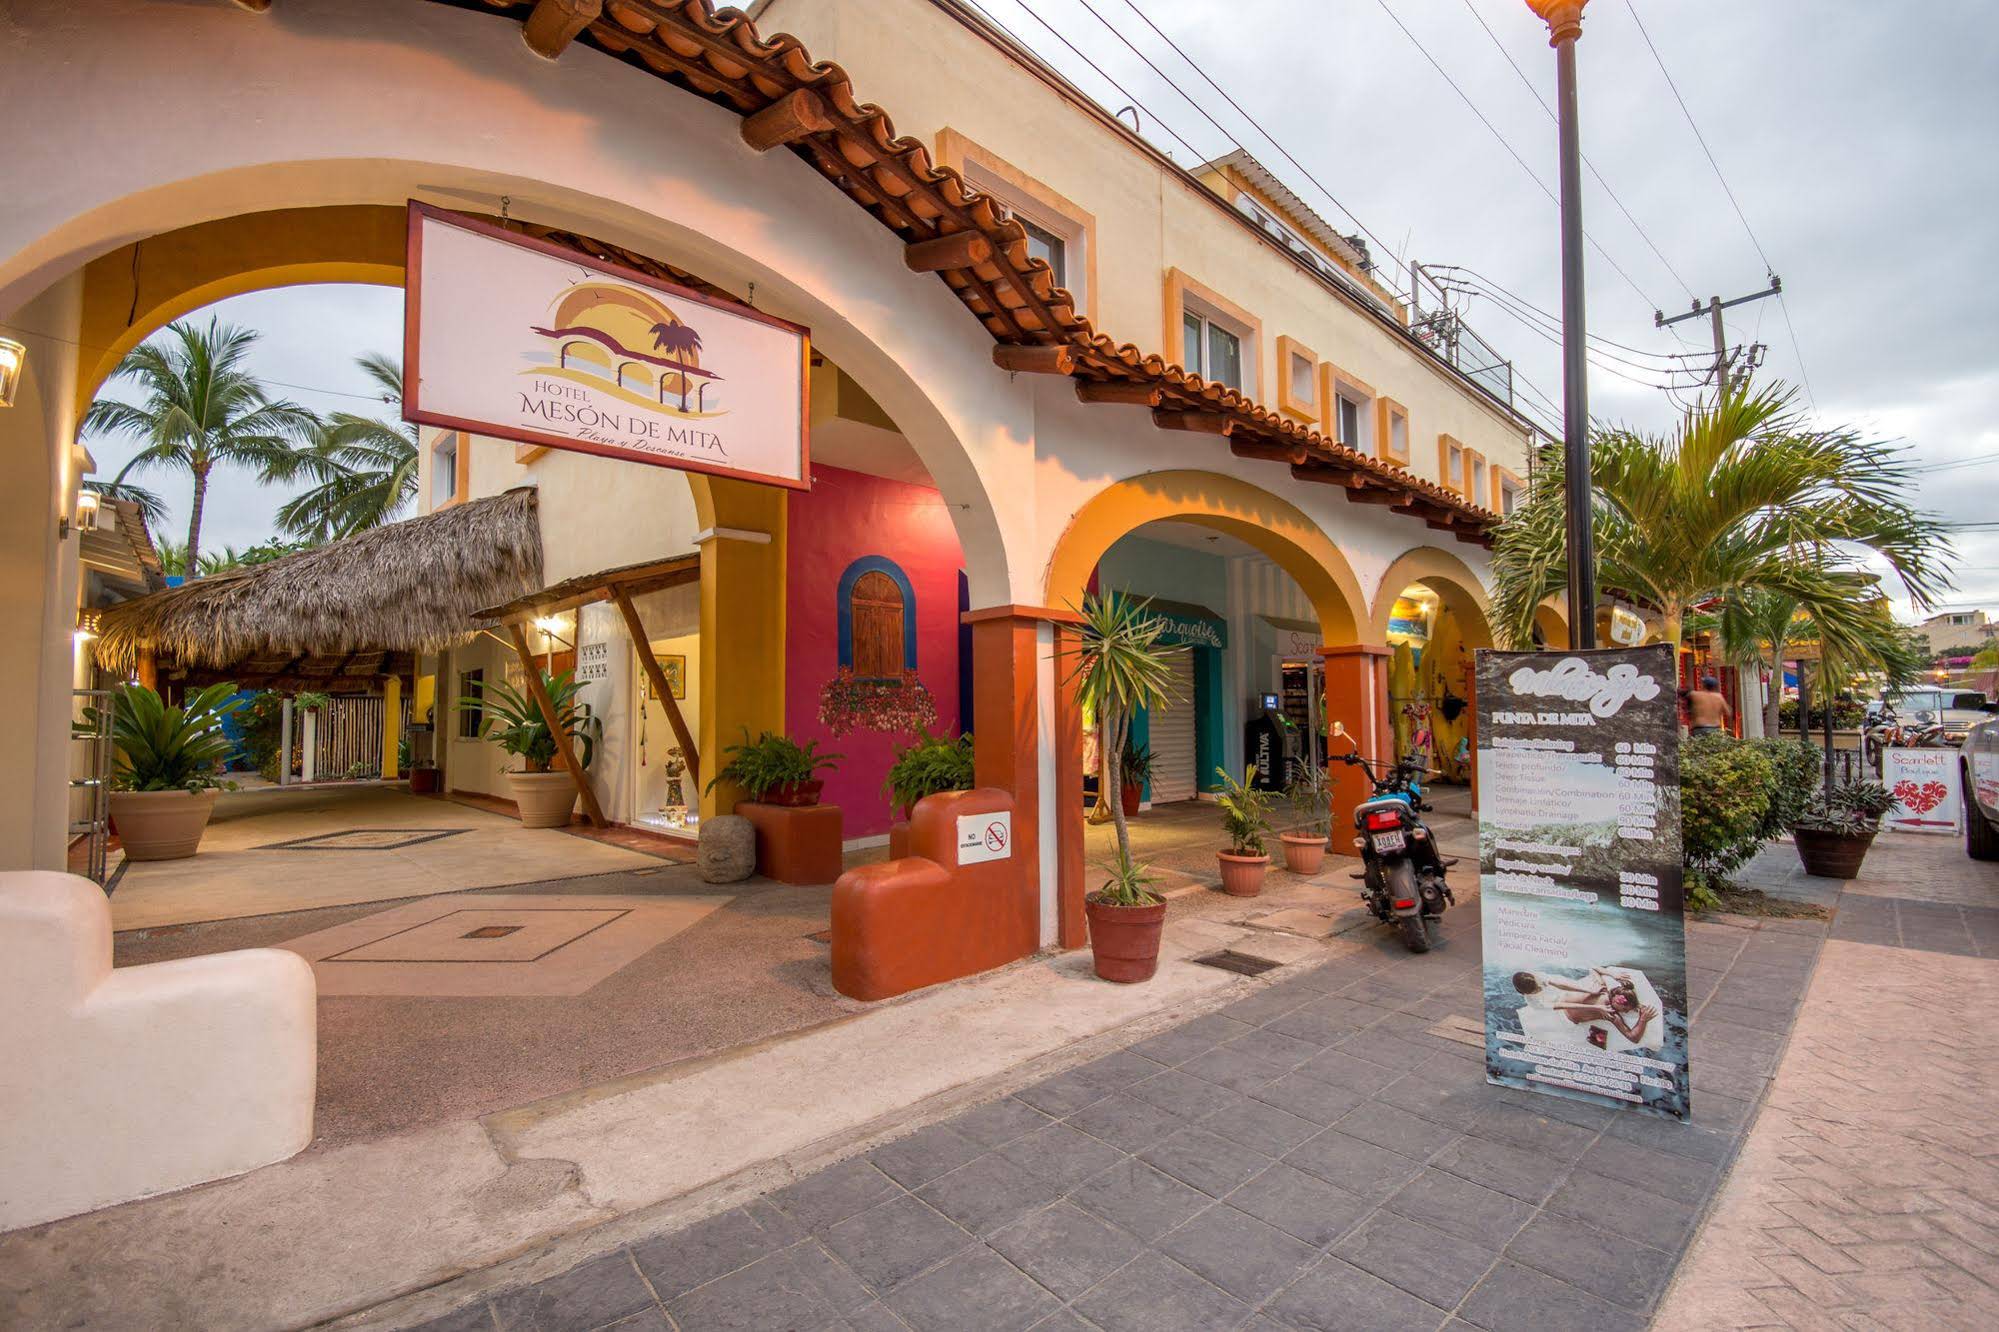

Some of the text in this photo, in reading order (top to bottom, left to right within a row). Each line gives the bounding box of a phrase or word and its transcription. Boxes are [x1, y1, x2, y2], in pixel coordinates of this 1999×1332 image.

[535, 380, 591, 402] HOTEL
[518, 392, 728, 457] MESÓN DE MITA
[576, 427, 614, 445] Playa
[1615, 742, 1631, 754] 60
[1633, 742, 1656, 754] Min
[1259, 733, 1270, 783] MULTIVA
[1616, 754, 1631, 765] 60
[1631, 755, 1653, 766] Min
[1892, 752, 1946, 766] Scarlett
[1616, 767, 1631, 777] 60
[1631, 767, 1654, 778] Min
[1620, 896, 1659, 910] 30 Min
